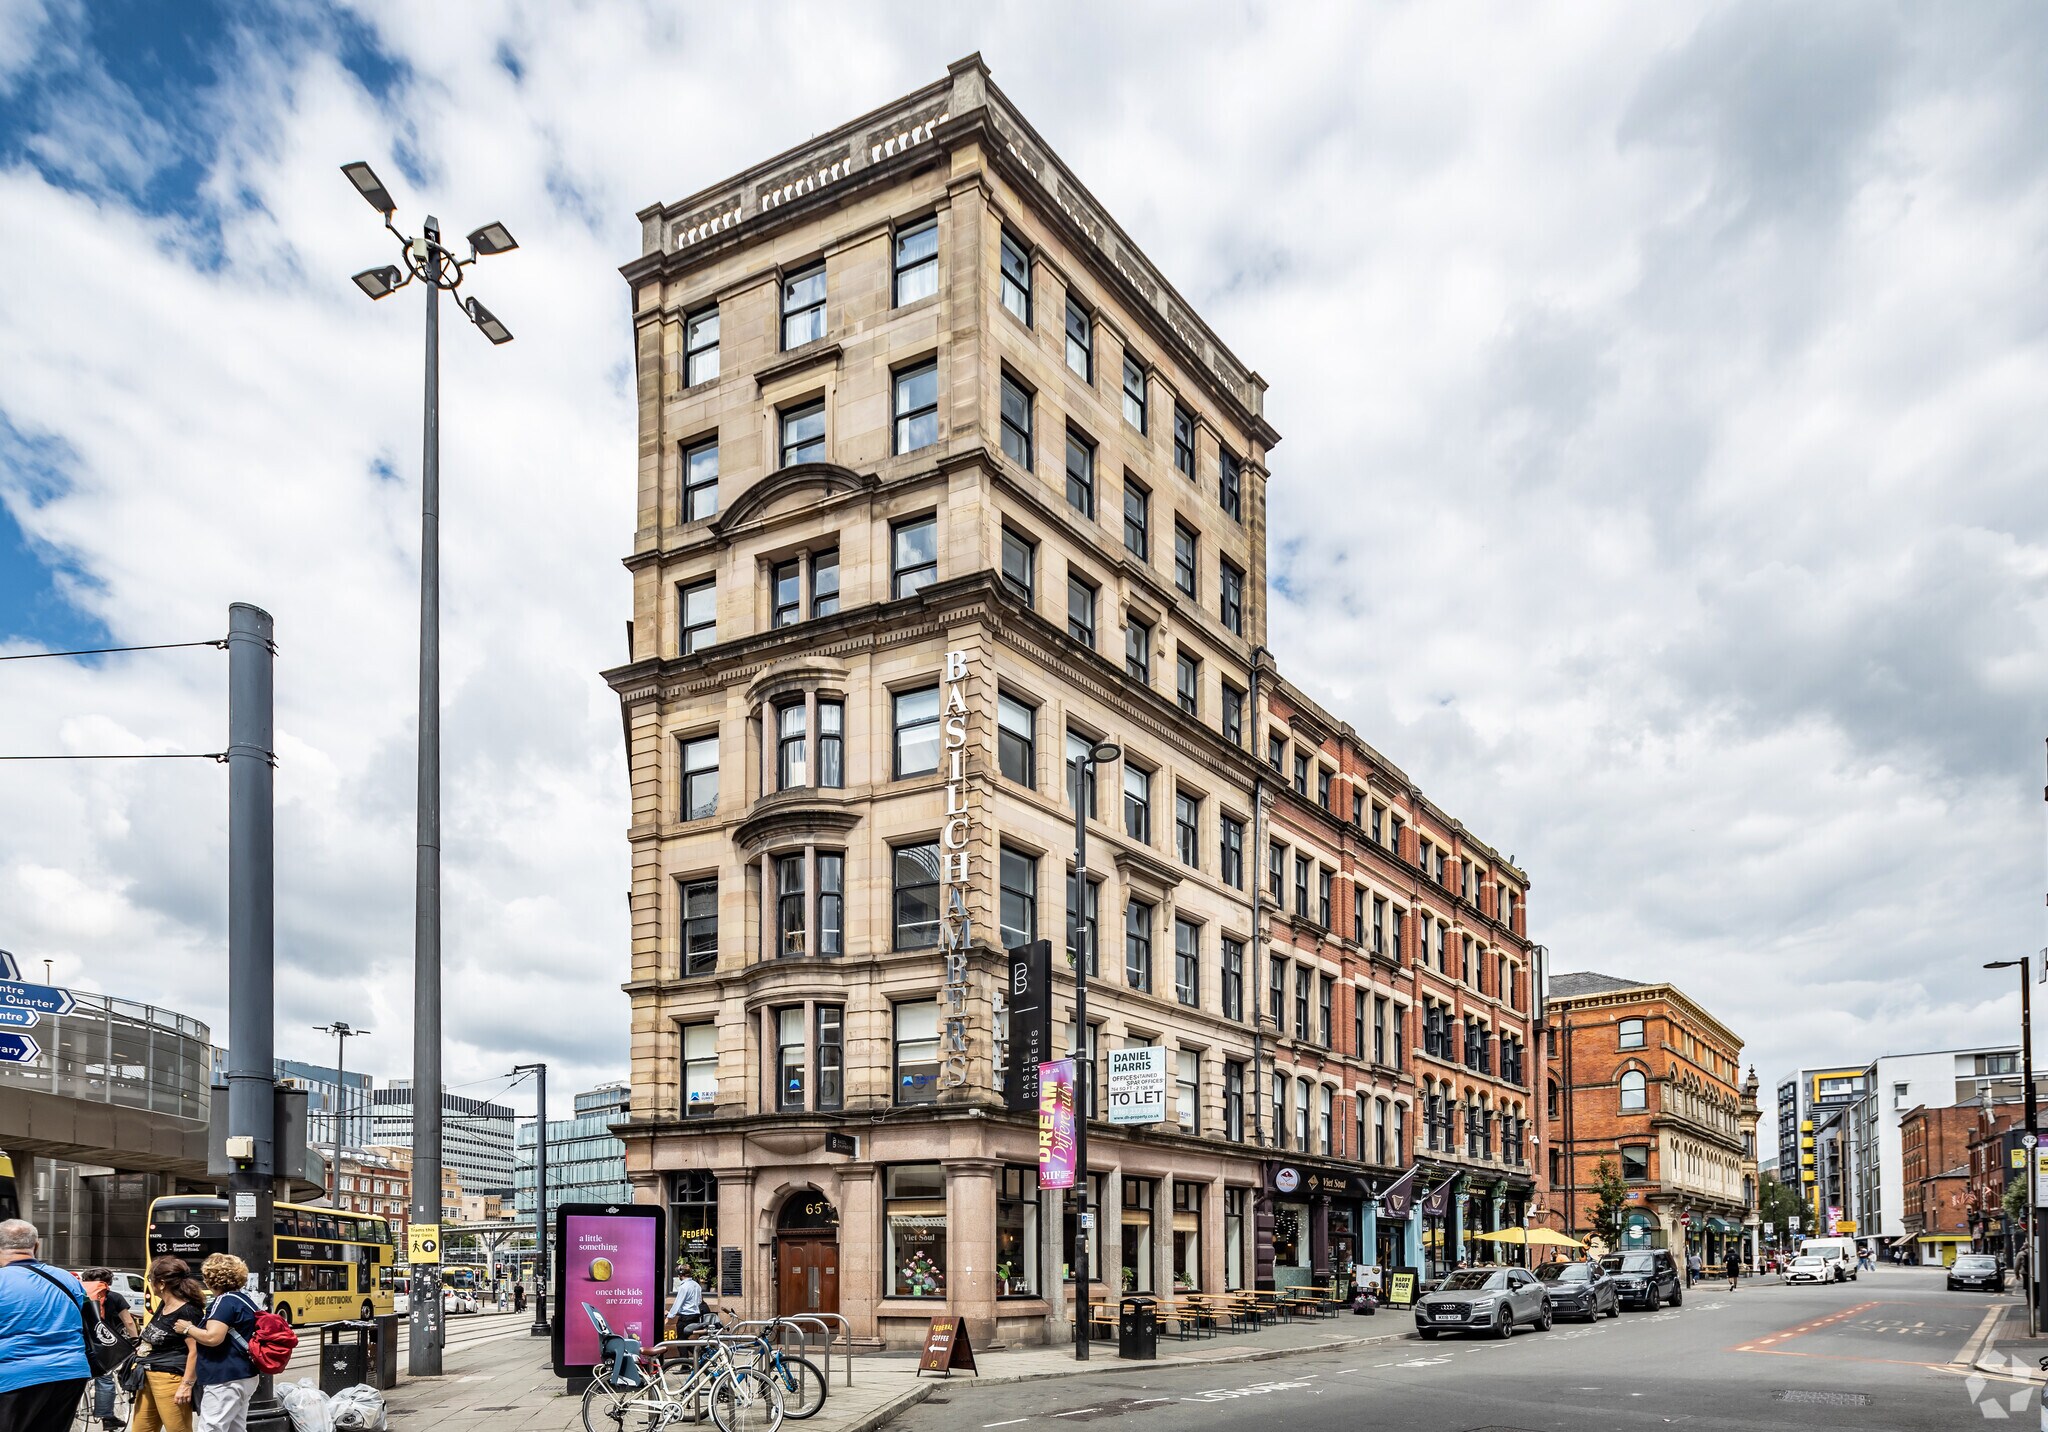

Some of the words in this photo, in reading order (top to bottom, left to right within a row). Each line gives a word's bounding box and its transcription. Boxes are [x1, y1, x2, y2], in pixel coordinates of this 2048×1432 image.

[943, 650, 970, 816] BASIL
[939, 818, 974, 1087] CHAMBERS
[5, 995, 54, 1008] Quarter
[1114, 1051, 1151, 1062] DANIEL
[1030, 1029, 1039, 1098] CHAMBERS
[1114, 1061, 1151, 1072] HARRIS
[1022, 1056, 1031, 1099] BASIL
[1112, 1074, 1138, 1082] OFFICES
[1110, 1092, 1130, 1105] TO
[1135, 1090, 1163, 1104] LET
[1039, 1081, 1058, 1163] DREAM
[1052, 1081, 1073, 1163] Differently
[1041, 1170, 1060, 1181] MIF
[1322, 1177, 1334, 1187] Viet
[1334, 1179, 1346, 1189] Soul
[805, 1203, 822, 1215] 65
[585, 1234, 603, 1242] little
[681, 1228, 714, 1239] FEDERAL
[156, 1243, 168, 1252] 33
[578, 1243, 618, 1252] something
[595, 1288, 613, 1296] once
[614, 1288, 626, 1296] the
[627, 1287, 643, 1296] kids
[314, 1296, 326, 1306] BEE
[326, 1295, 353, 1305] NETWORK
[618, 1297, 643, 1306] zzzing
[932, 1324, 953, 1332] FEDERAL
